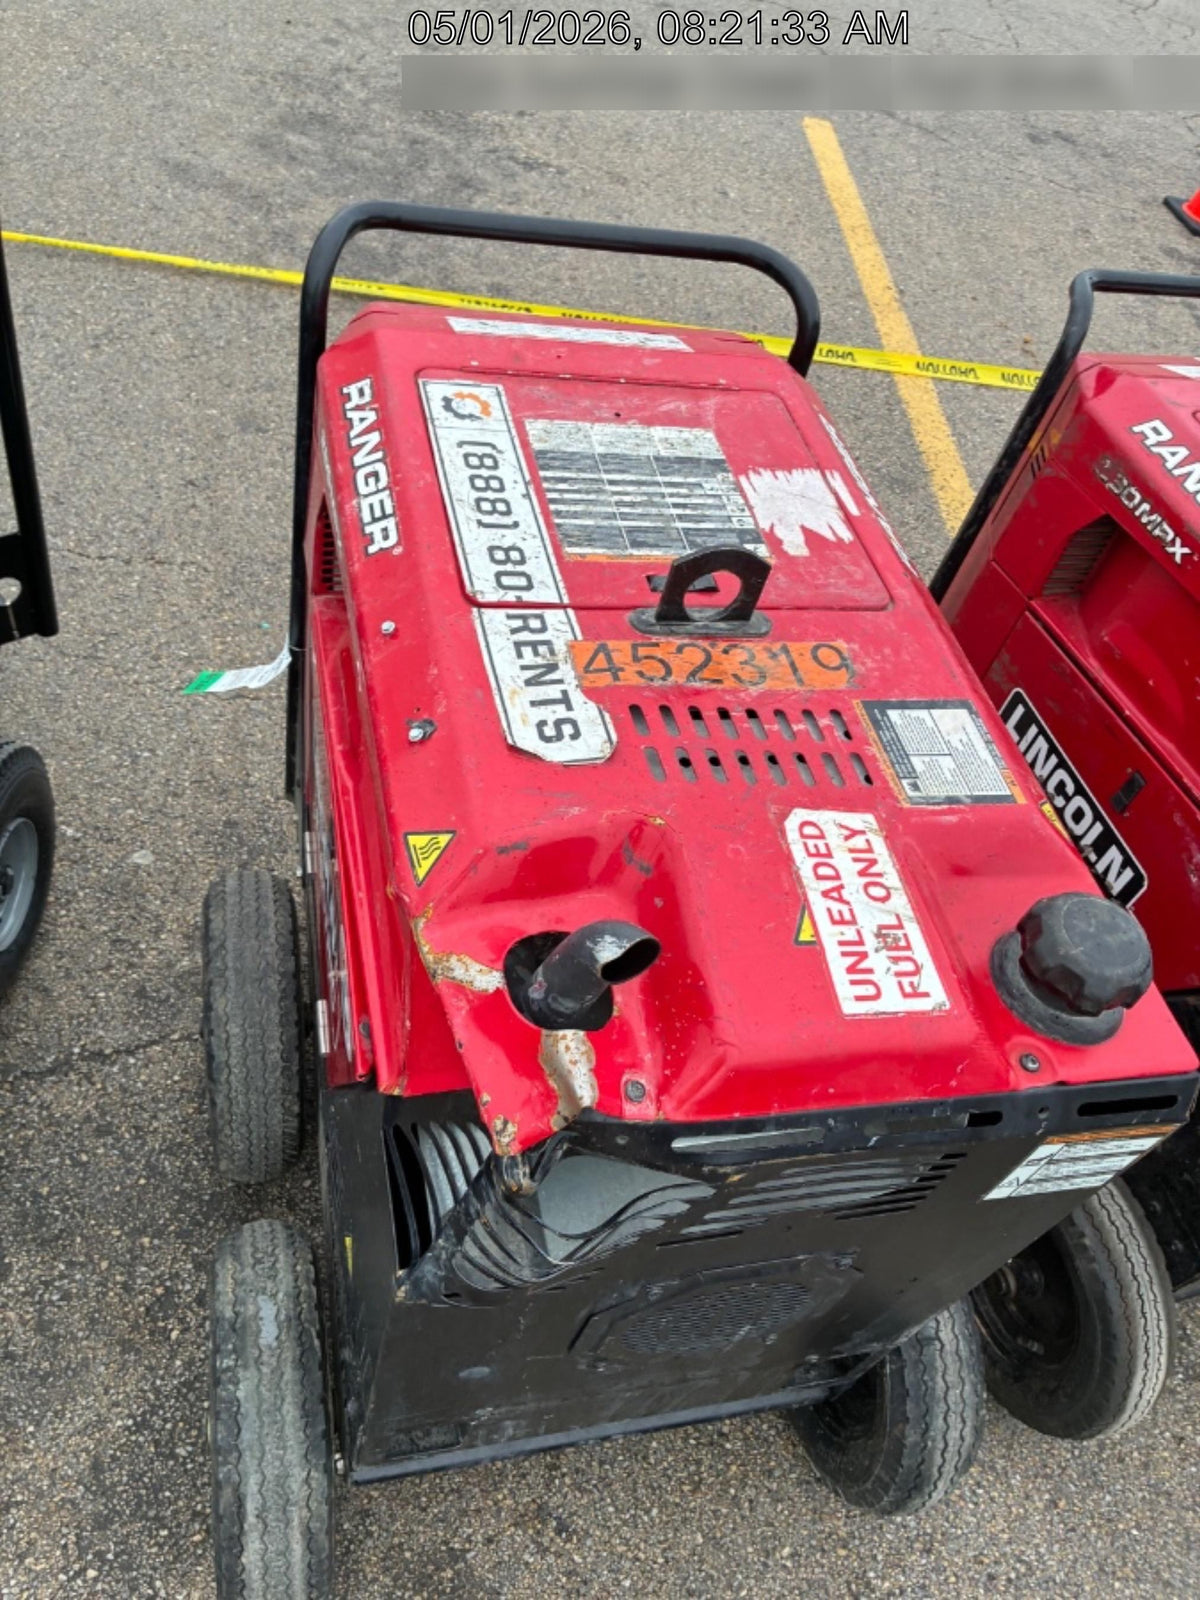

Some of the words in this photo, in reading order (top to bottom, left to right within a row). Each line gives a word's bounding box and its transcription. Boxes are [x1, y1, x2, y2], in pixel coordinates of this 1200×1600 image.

[342, 377, 399, 557] RANGER
[456, 440, 520, 530] (888)
[1130, 418, 1200, 505] RAN
[582, 641, 857, 689] 452319
[1005, 703, 1135, 897] LINCOLN
[839, 824, 892, 904] ONLY
[798, 820, 882, 1002] UNLEADED
[876, 913, 931, 999] FUEL
